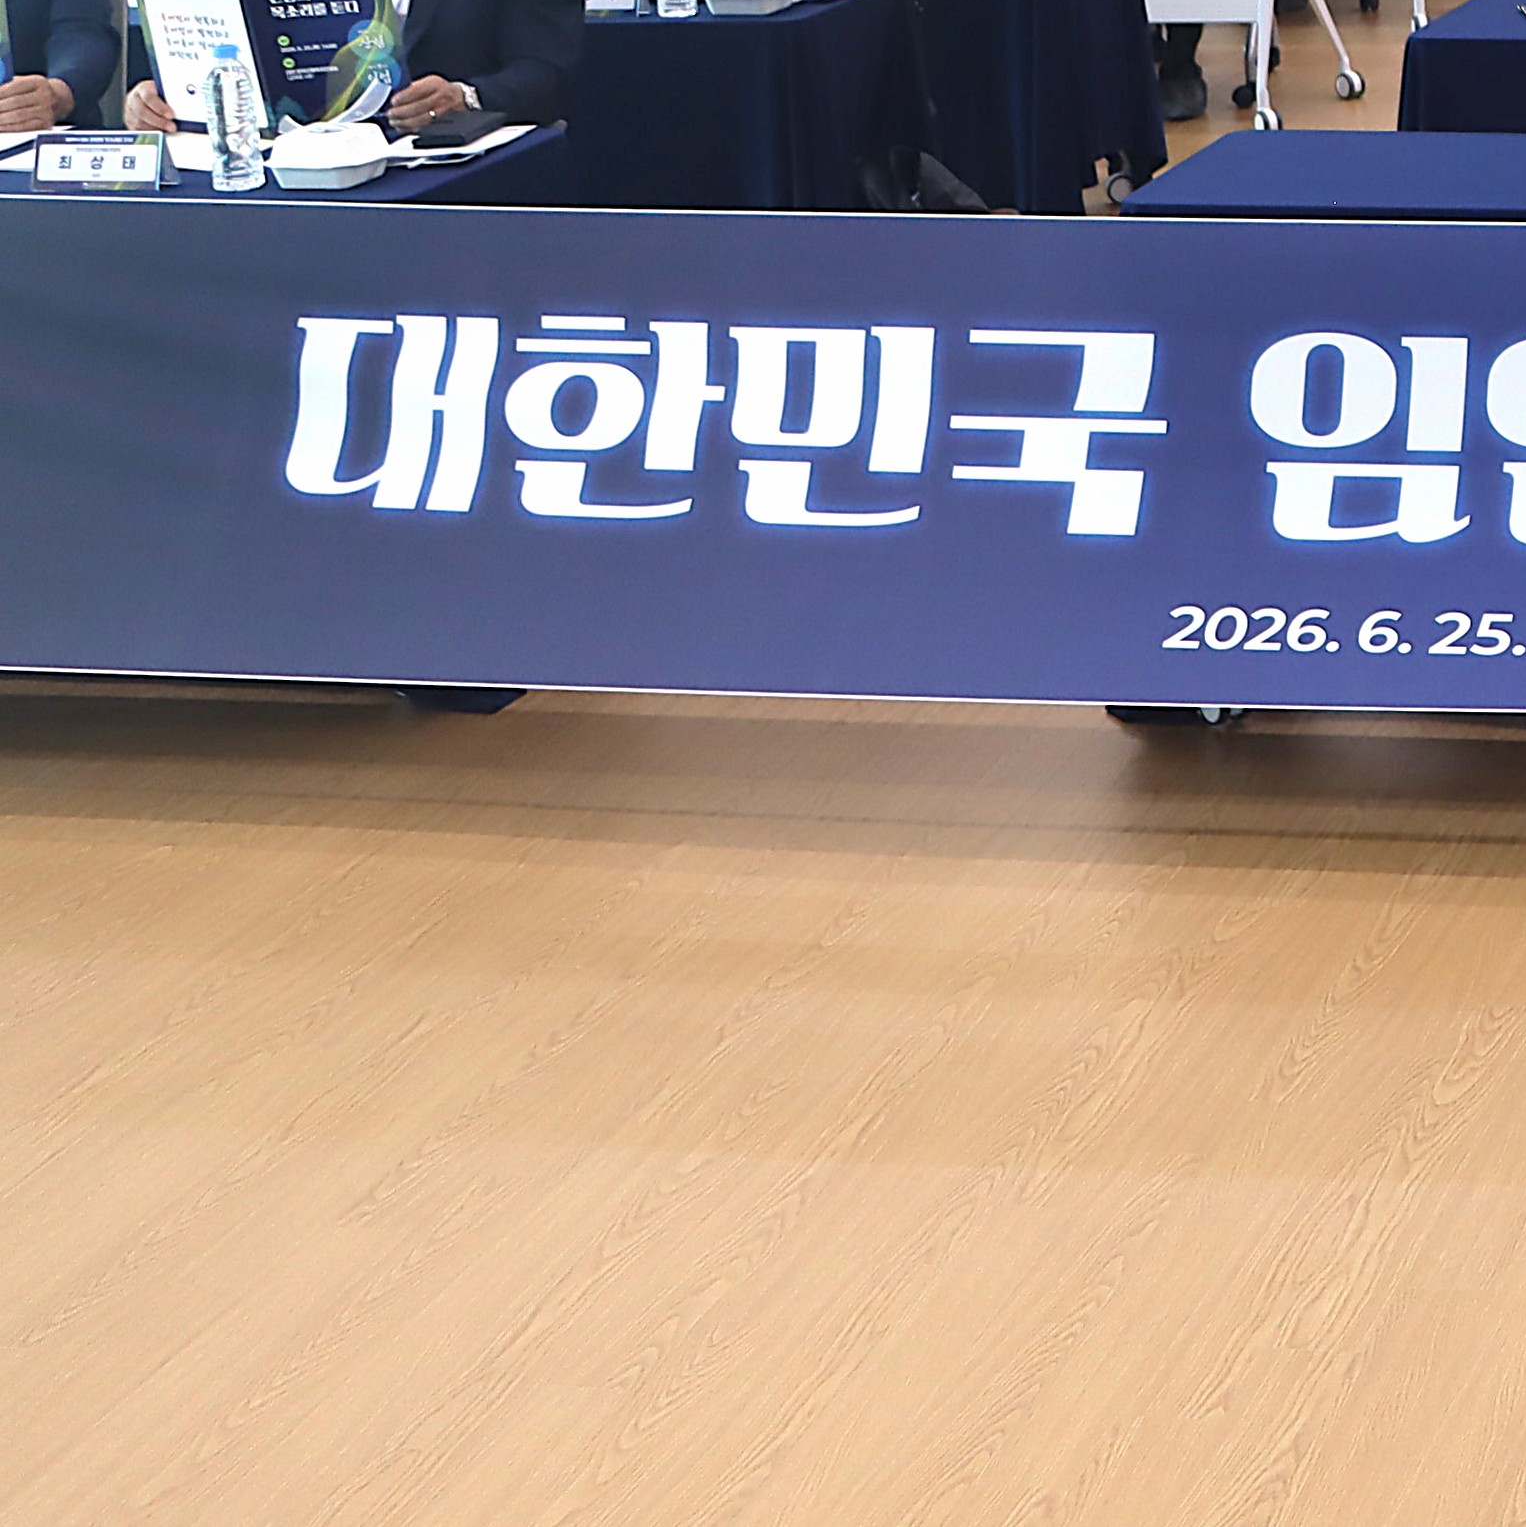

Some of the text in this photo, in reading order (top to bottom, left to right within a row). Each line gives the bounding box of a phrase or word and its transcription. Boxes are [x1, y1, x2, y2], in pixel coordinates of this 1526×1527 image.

[286, 315, 1167, 536] 대한민국
[1162, 605, 1340, 652] 2026.
[1358, 610, 1412, 654] 6.
